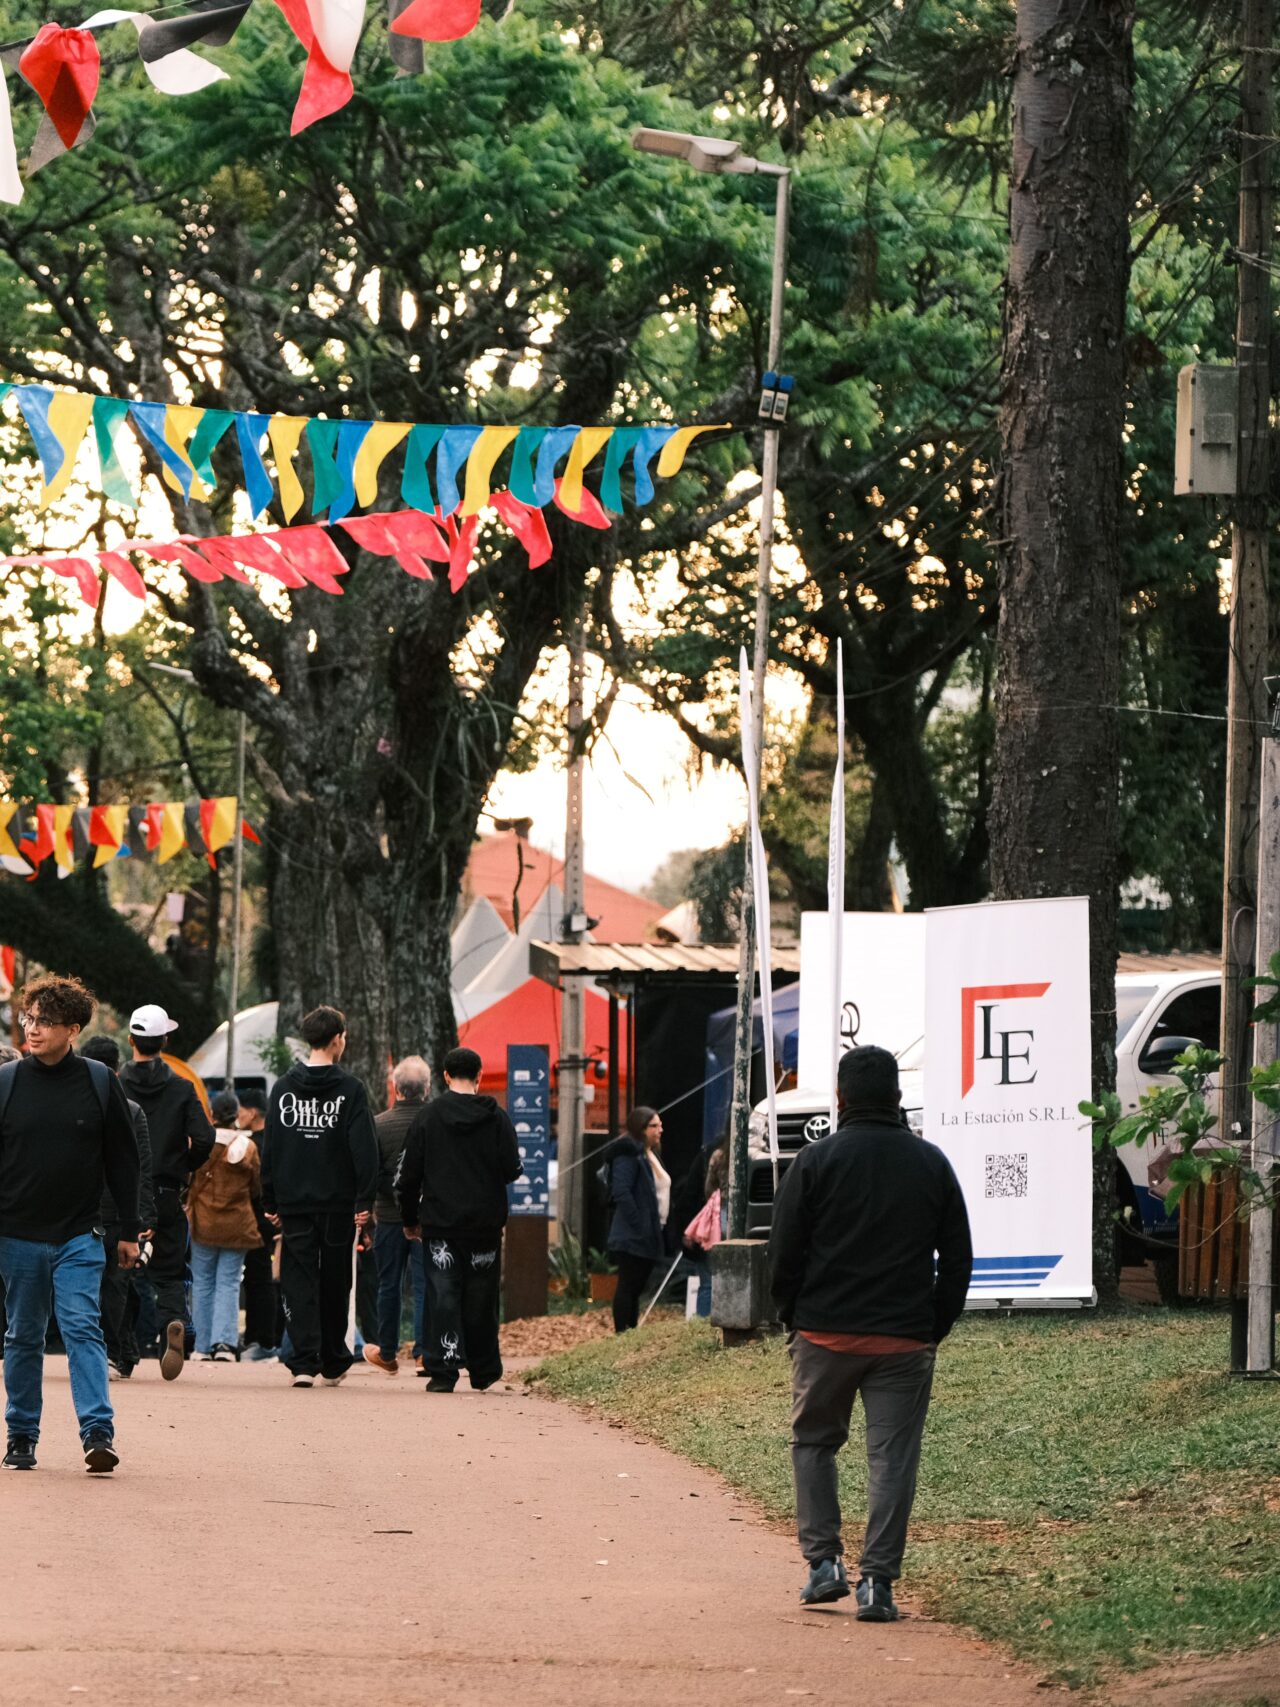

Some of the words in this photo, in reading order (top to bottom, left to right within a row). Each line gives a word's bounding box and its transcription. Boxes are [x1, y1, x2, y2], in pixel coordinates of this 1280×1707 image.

[278, 1091, 320, 1115] Out
[322, 1095, 346, 1115] of
[280, 1106, 339, 1129] Office
[941, 1112, 959, 1127] La
[964, 1108, 1024, 1125] Estación
[1028, 1107, 1076, 1122] S.R.L.
